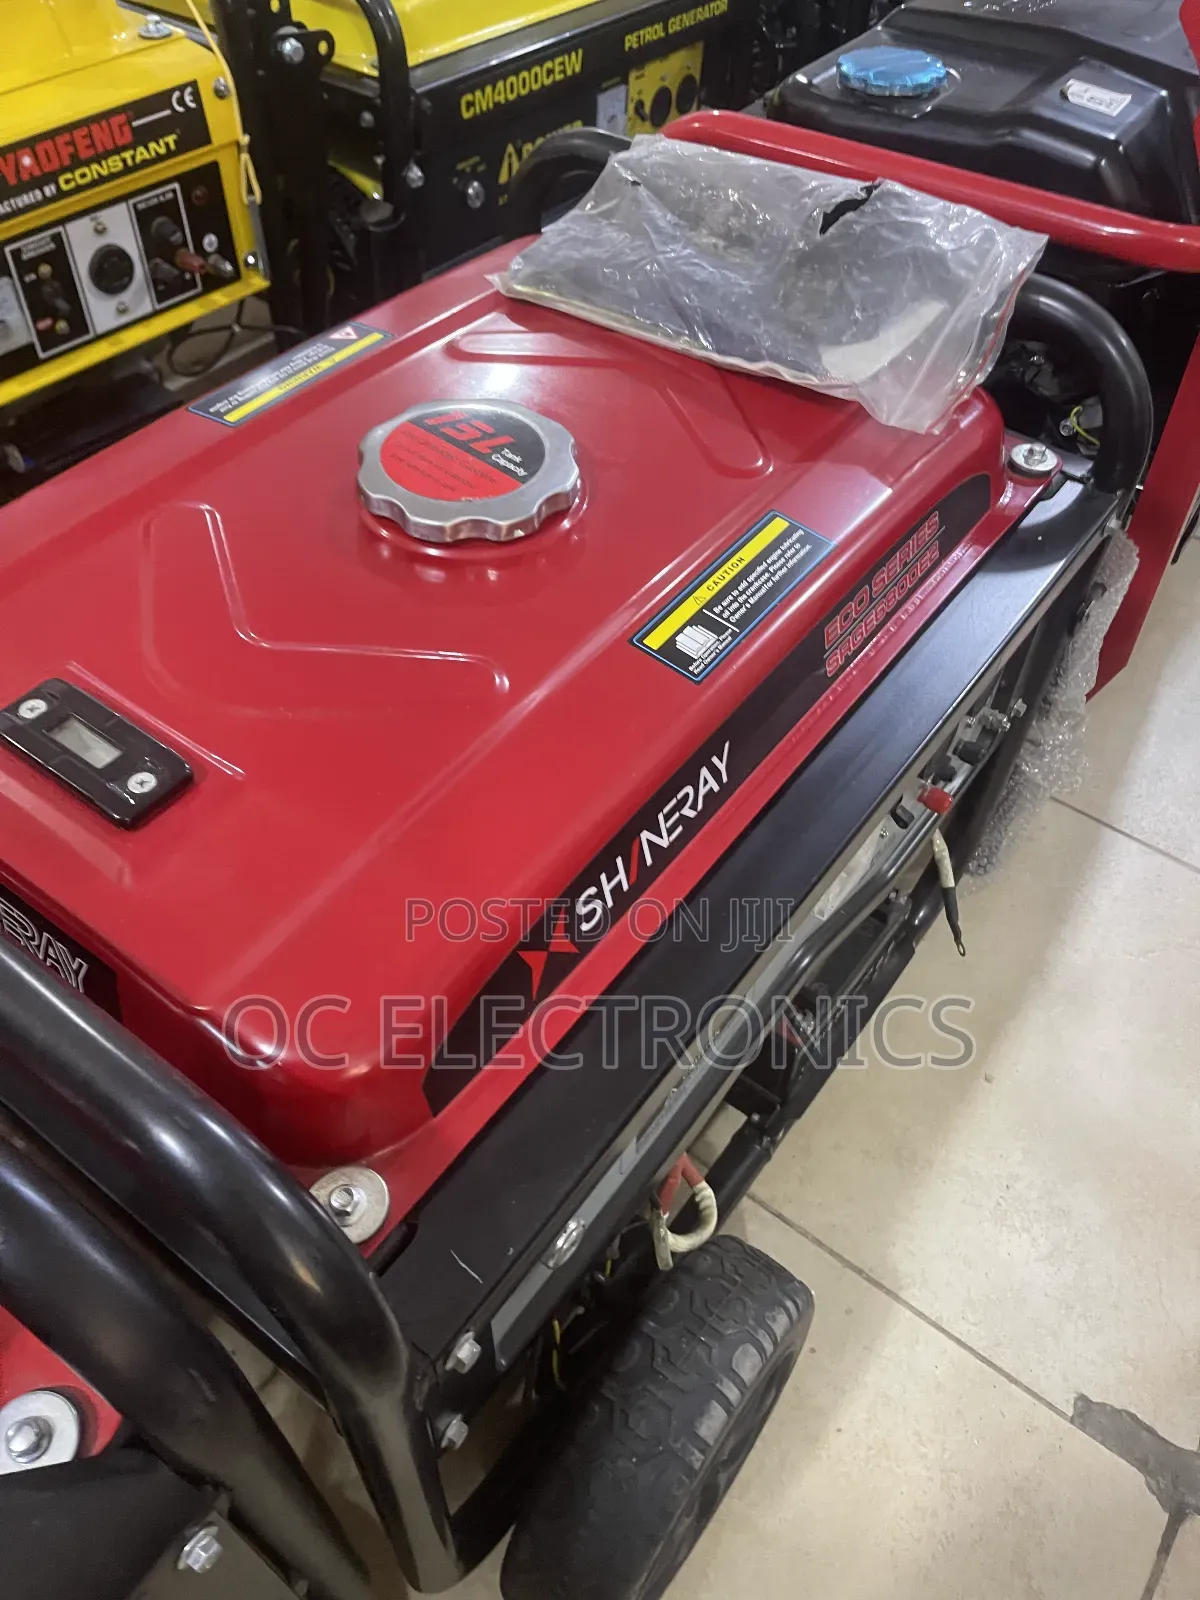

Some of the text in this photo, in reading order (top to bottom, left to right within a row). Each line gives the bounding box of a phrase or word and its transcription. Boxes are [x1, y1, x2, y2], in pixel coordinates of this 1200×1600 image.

[624, 0, 728, 52] PETROL GENERATOR
[459, 48, 584, 120] CM4000CEW
[0, 112, 133, 187] YAOFENG
[58, 133, 178, 192] CONSTANT
[706, 556, 746, 592] CAUTION
[712, 528, 805, 615] Be sure to add specified engine lubricating
[722, 609, 731, 619] oil
[727, 601, 740, 613] into
[737, 593, 749, 604] the
[768, 556, 786, 573] Please
[784, 547, 796, 560] refer
[793, 542, 801, 550] to
[771, 565, 788, 583] further
[824, 510, 940, 650] ECO SERIES
[574, 739, 730, 932] SHINERAY
